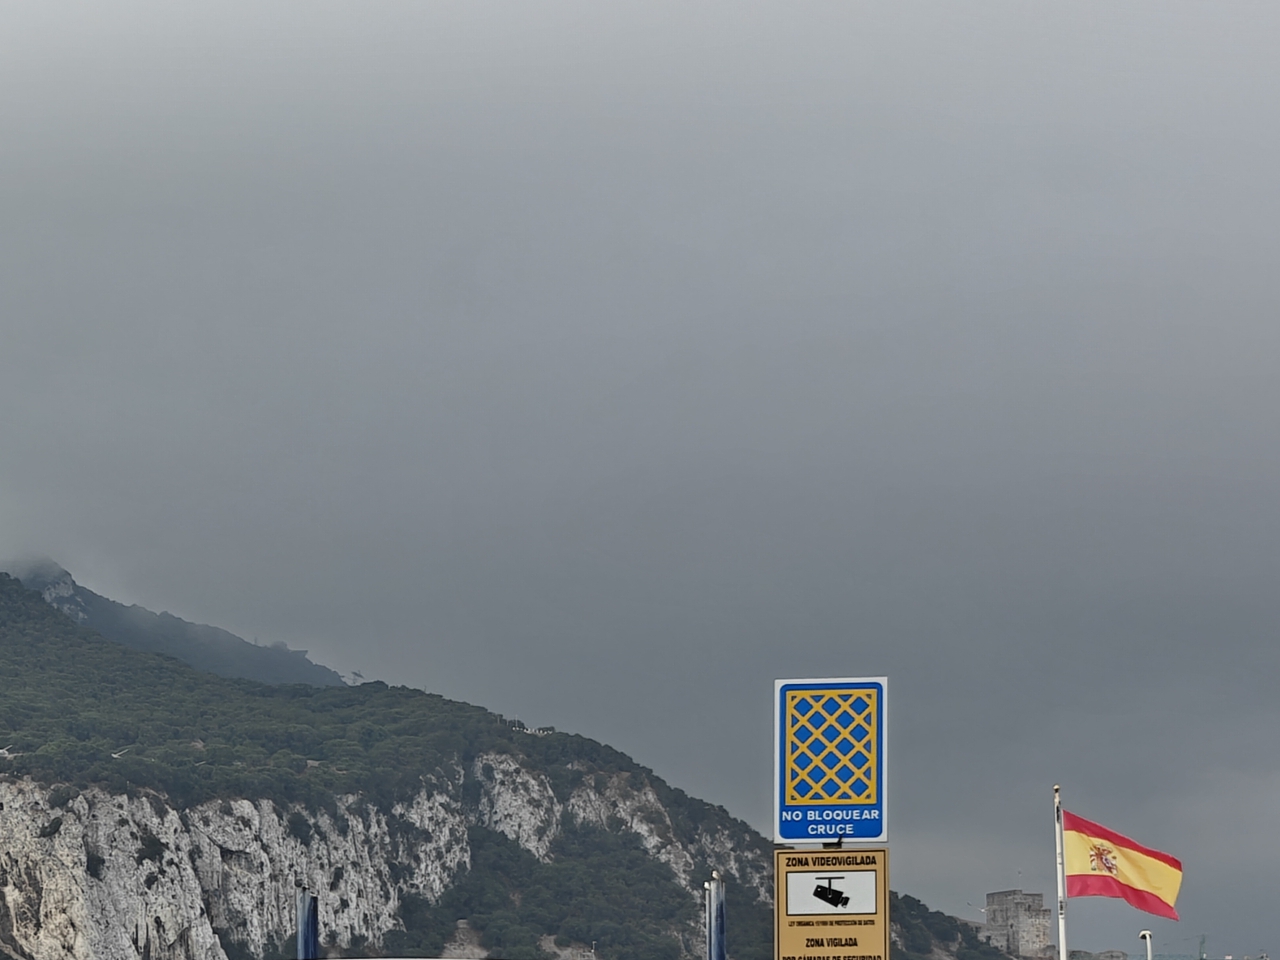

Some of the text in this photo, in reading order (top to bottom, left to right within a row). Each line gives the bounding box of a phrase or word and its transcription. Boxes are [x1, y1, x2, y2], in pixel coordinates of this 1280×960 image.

[782, 809, 879, 821] NO BLOQUEAR
[807, 824, 854, 835] CRUCE
[785, 856, 877, 867] ZONA VIDEOVIGILADA
[805, 937, 858, 948] ZONA VIGILADA
